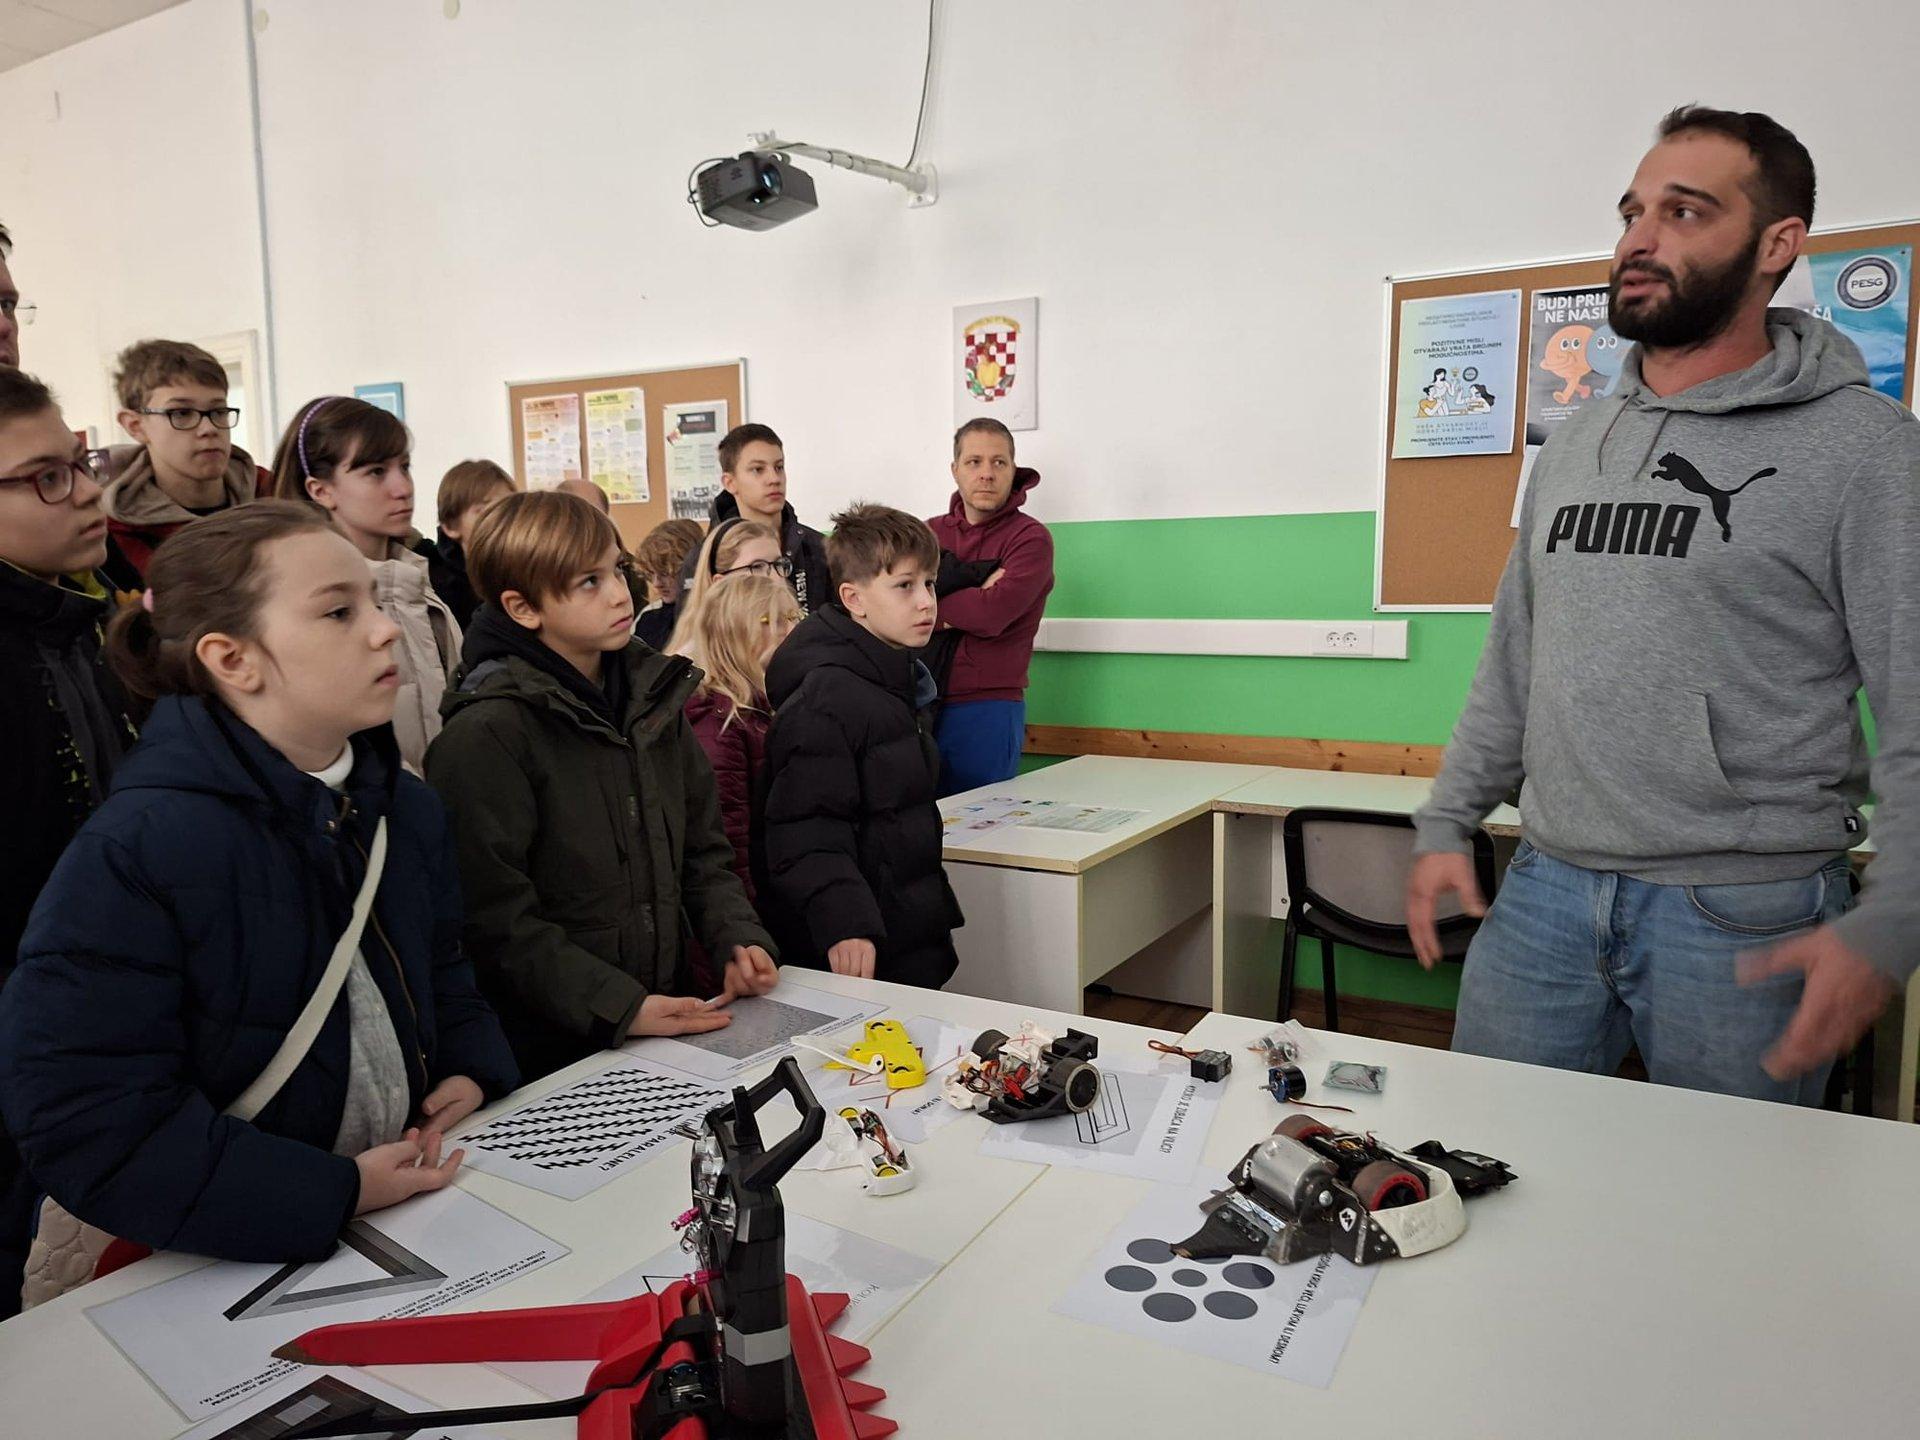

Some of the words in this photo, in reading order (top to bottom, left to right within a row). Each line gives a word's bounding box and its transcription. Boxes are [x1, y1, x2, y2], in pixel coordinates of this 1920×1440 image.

[1851, 277, 1883, 290] PESG
[1537, 295, 1572, 311] BUDI
[1545, 311, 1565, 323] NE
[1431, 339, 1466, 347] POZITIVNE
[1546, 502, 1701, 558] PUMA
[795, 571, 807, 601] NEW
[599, 1134, 667, 1171] PARALELNE?
